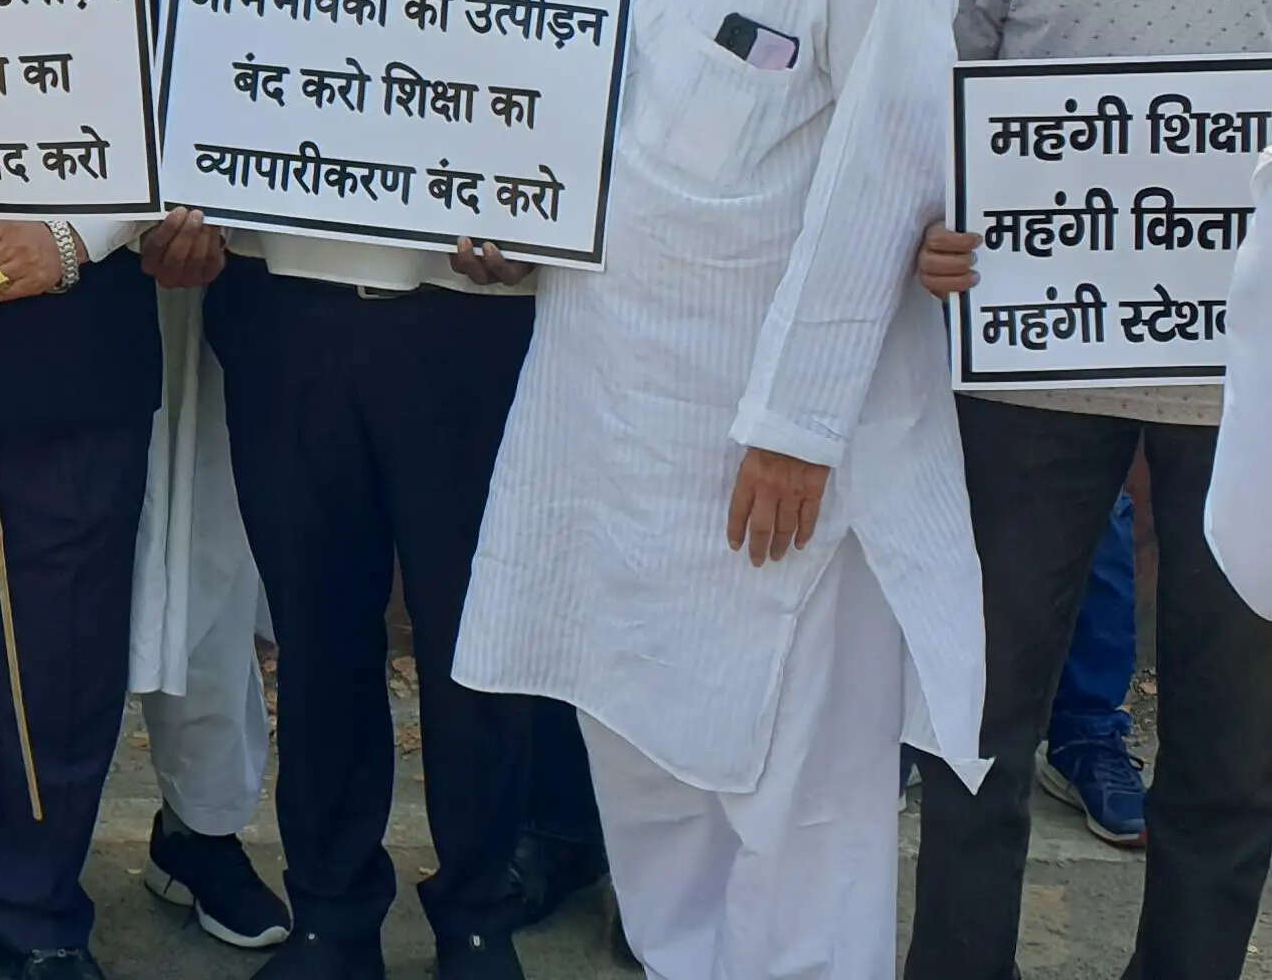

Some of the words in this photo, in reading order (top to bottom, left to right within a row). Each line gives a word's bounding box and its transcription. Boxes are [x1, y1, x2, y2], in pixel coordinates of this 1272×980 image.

[18, 53, 73, 94] का
[231, 52, 291, 107] बंद
[299, 57, 373, 113] करो
[380, 61, 480, 124] शिक्षा
[487, 85, 542, 130] का
[36, 125, 111, 181] करो
[988, 94, 1134, 162] महंगी
[193, 140, 417, 206] व्यापारीकरण
[425, 158, 486, 215] बंद
[493, 164, 566, 222] करो
[983, 187, 1119, 258] महंगी
[979, 282, 1108, 351] महंगी
